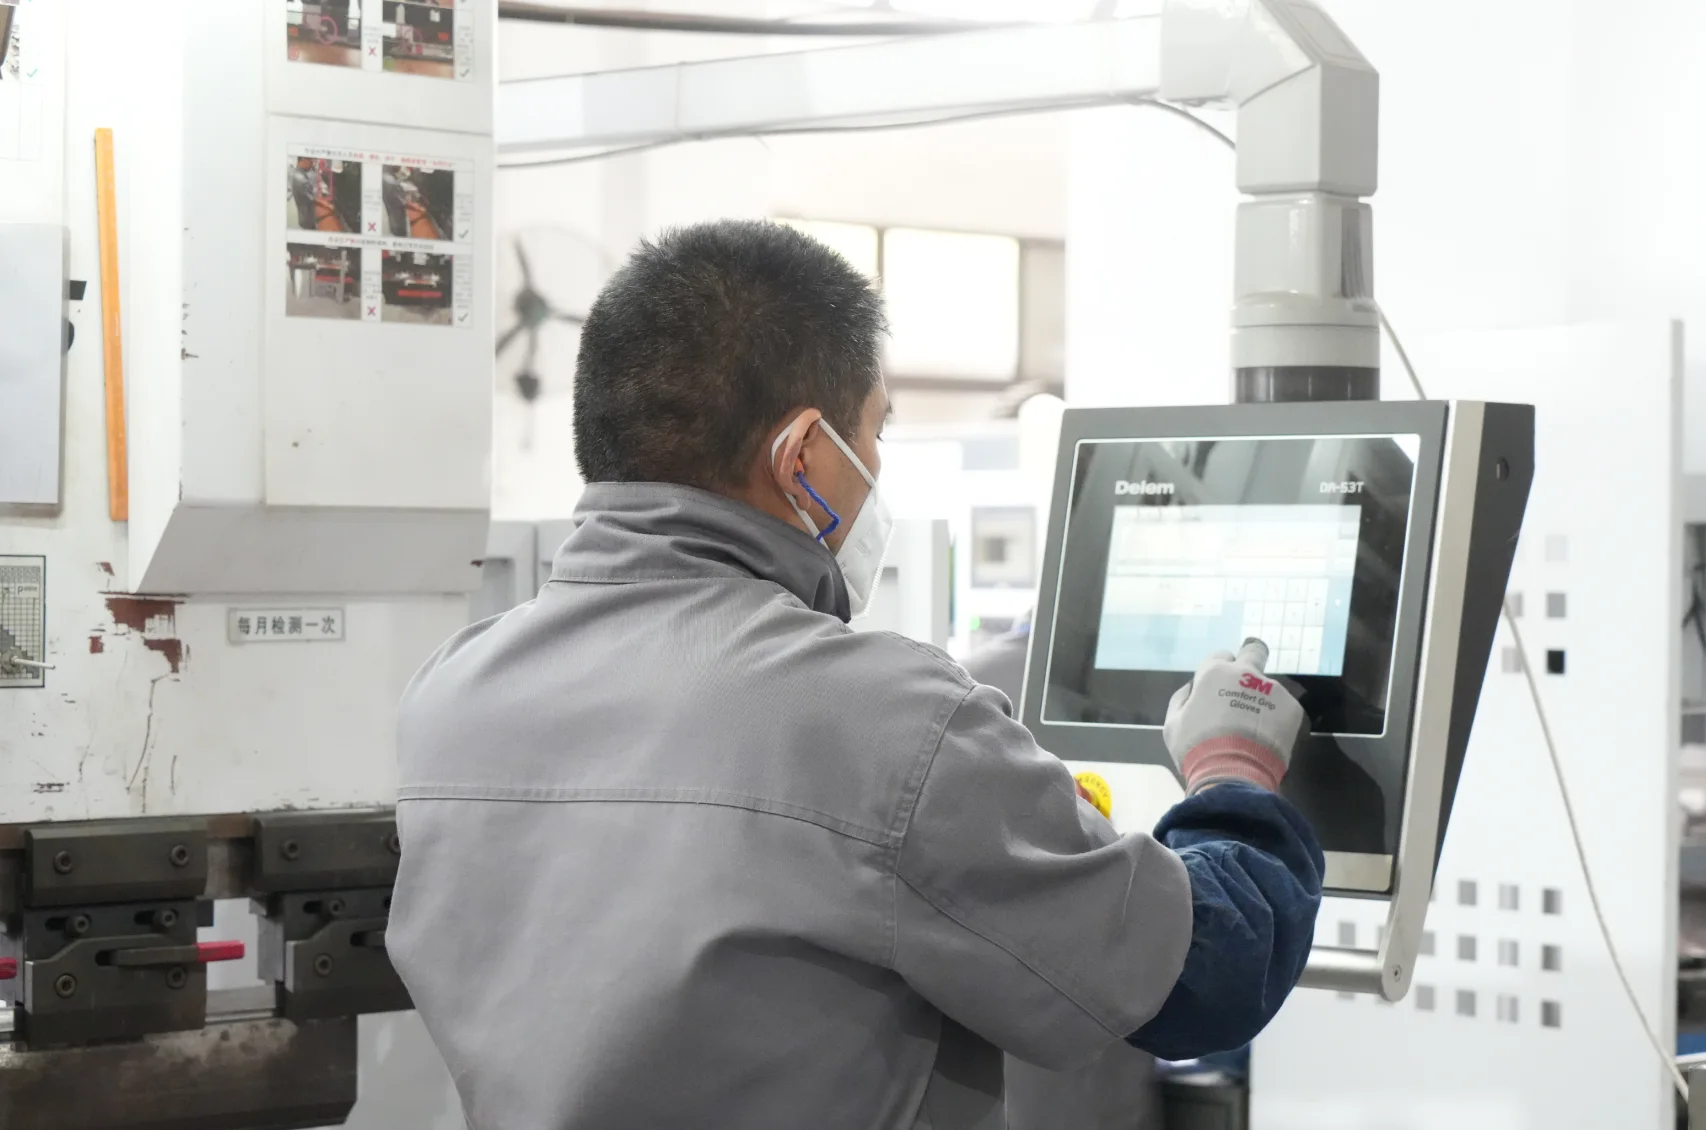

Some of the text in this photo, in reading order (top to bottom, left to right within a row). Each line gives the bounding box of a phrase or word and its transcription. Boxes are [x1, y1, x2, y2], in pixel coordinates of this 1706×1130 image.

[1115, 480, 1175, 495] Delem
[237, 615, 336, 635] 每月检测一次
[1239, 672, 1274, 696] 3M
[1218, 689, 1276, 711] Comfort Grip
[1230, 699, 1261, 714] Gloves
